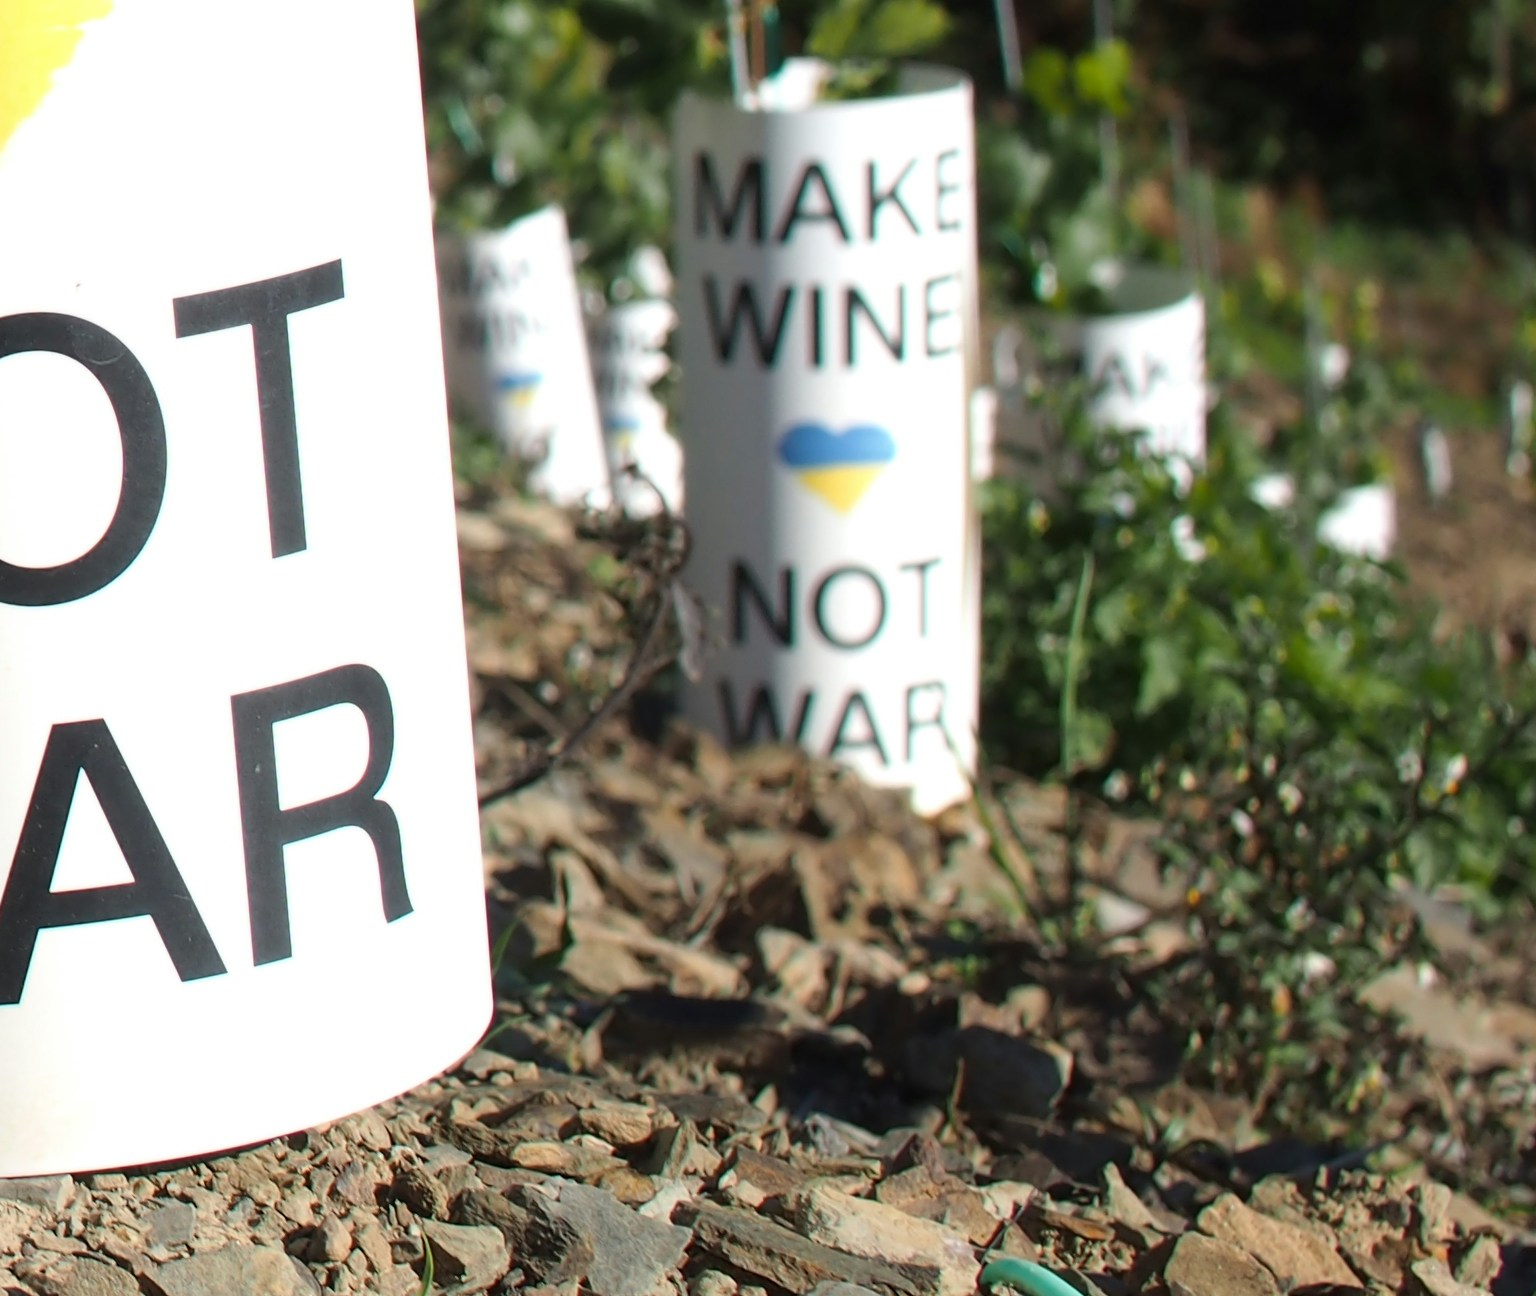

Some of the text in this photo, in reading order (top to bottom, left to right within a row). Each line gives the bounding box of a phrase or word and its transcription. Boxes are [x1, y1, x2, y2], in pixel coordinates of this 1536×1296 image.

[692, 147, 961, 247] MAKE
[702, 269, 962, 372] WINE
[732, 557, 941, 654] NOT
[715, 679, 954, 766] WAR
